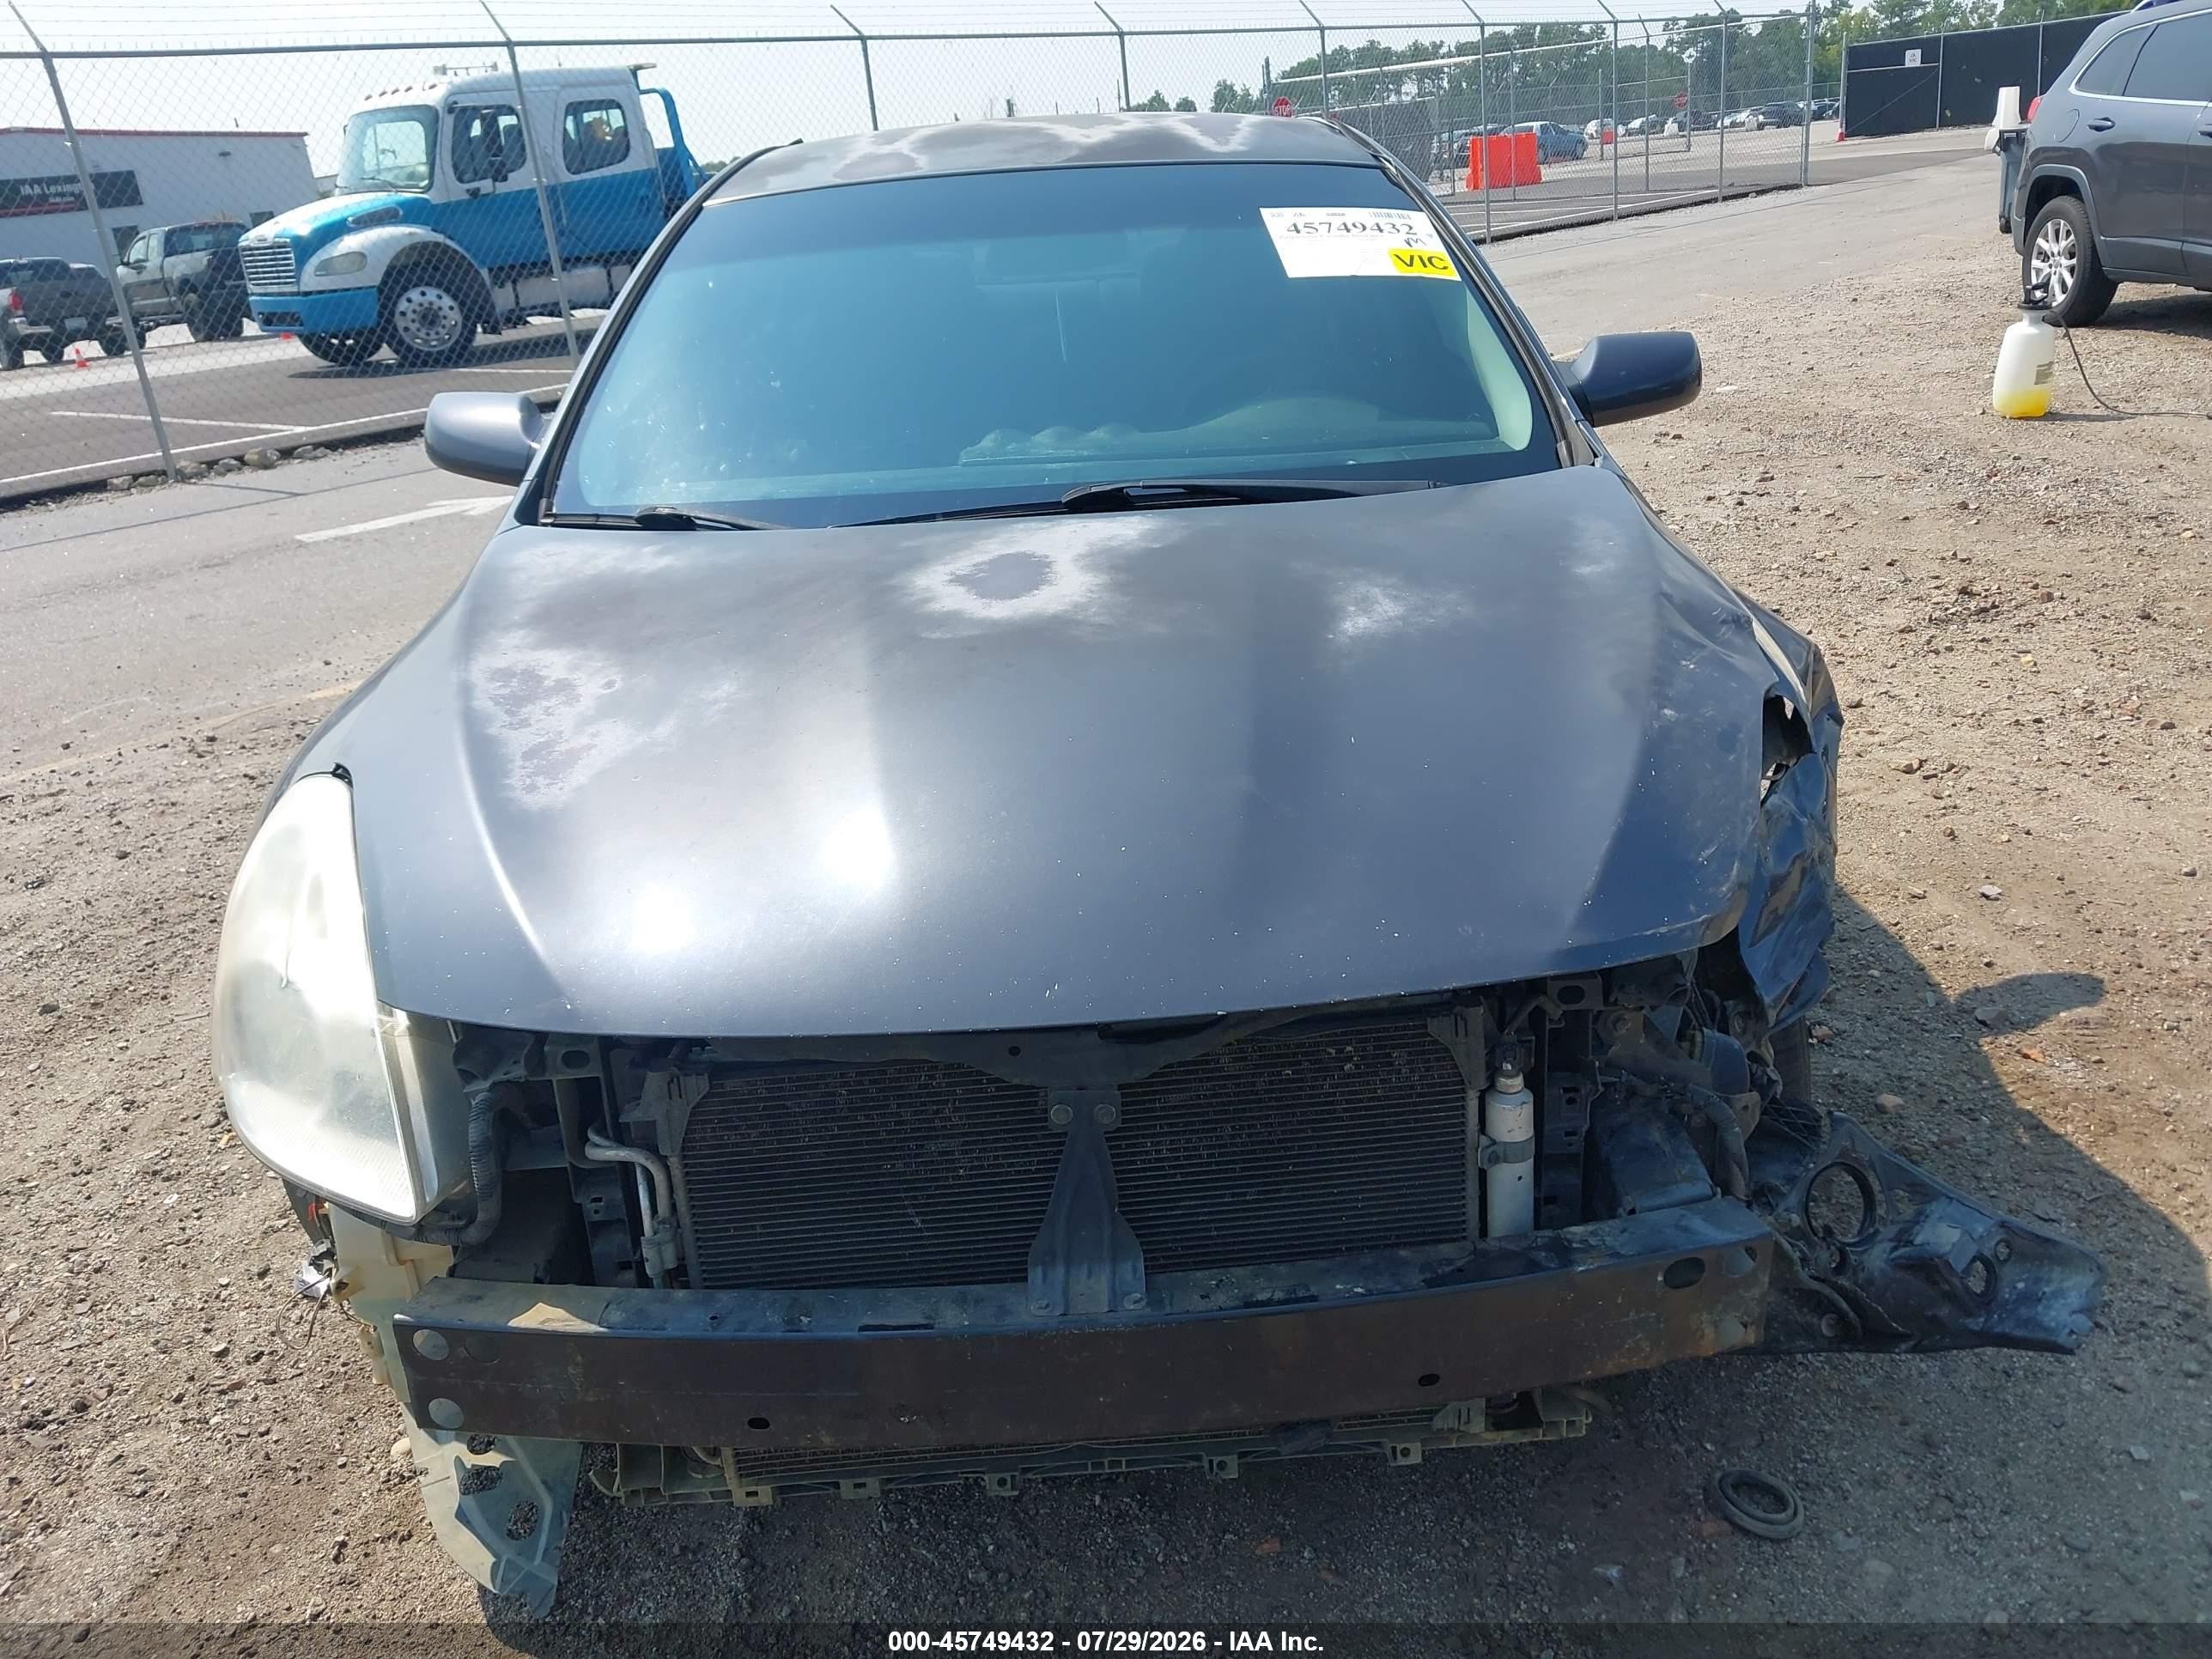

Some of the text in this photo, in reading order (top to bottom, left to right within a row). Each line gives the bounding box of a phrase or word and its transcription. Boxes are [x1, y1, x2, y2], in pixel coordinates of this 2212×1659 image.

[1274, 105, 1291, 117] STOP
[20, 182, 94, 195] IAA Lexingt
[1286, 222, 1418, 235] 45749432
[1393, 253, 1449, 270] VIC
